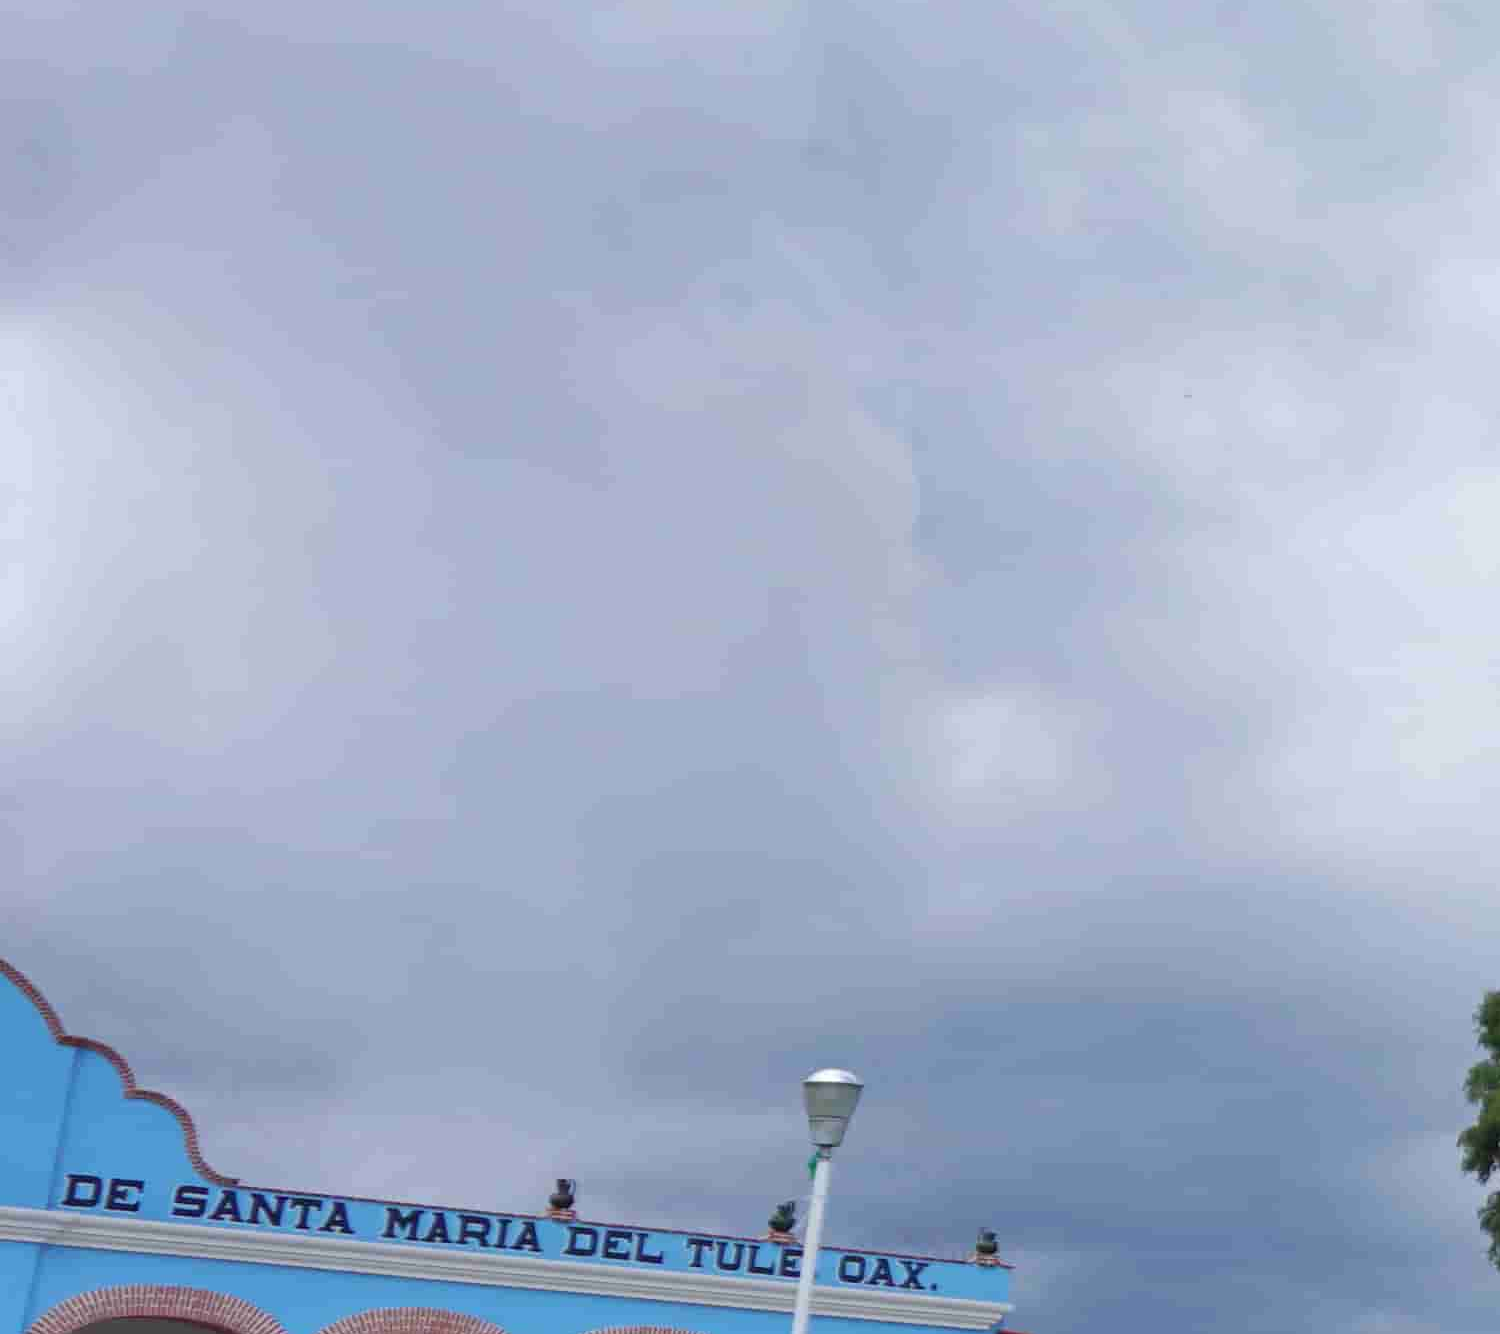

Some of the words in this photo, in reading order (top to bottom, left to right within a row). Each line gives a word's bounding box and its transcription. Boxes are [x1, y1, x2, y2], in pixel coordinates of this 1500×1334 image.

[62, 1173, 144, 1213] DE
[172, 1184, 355, 1234] SANTA
[381, 1206, 543, 1254] MARIA
[563, 1225, 664, 1264] DEL
[837, 1254, 938, 1291] OAX.
